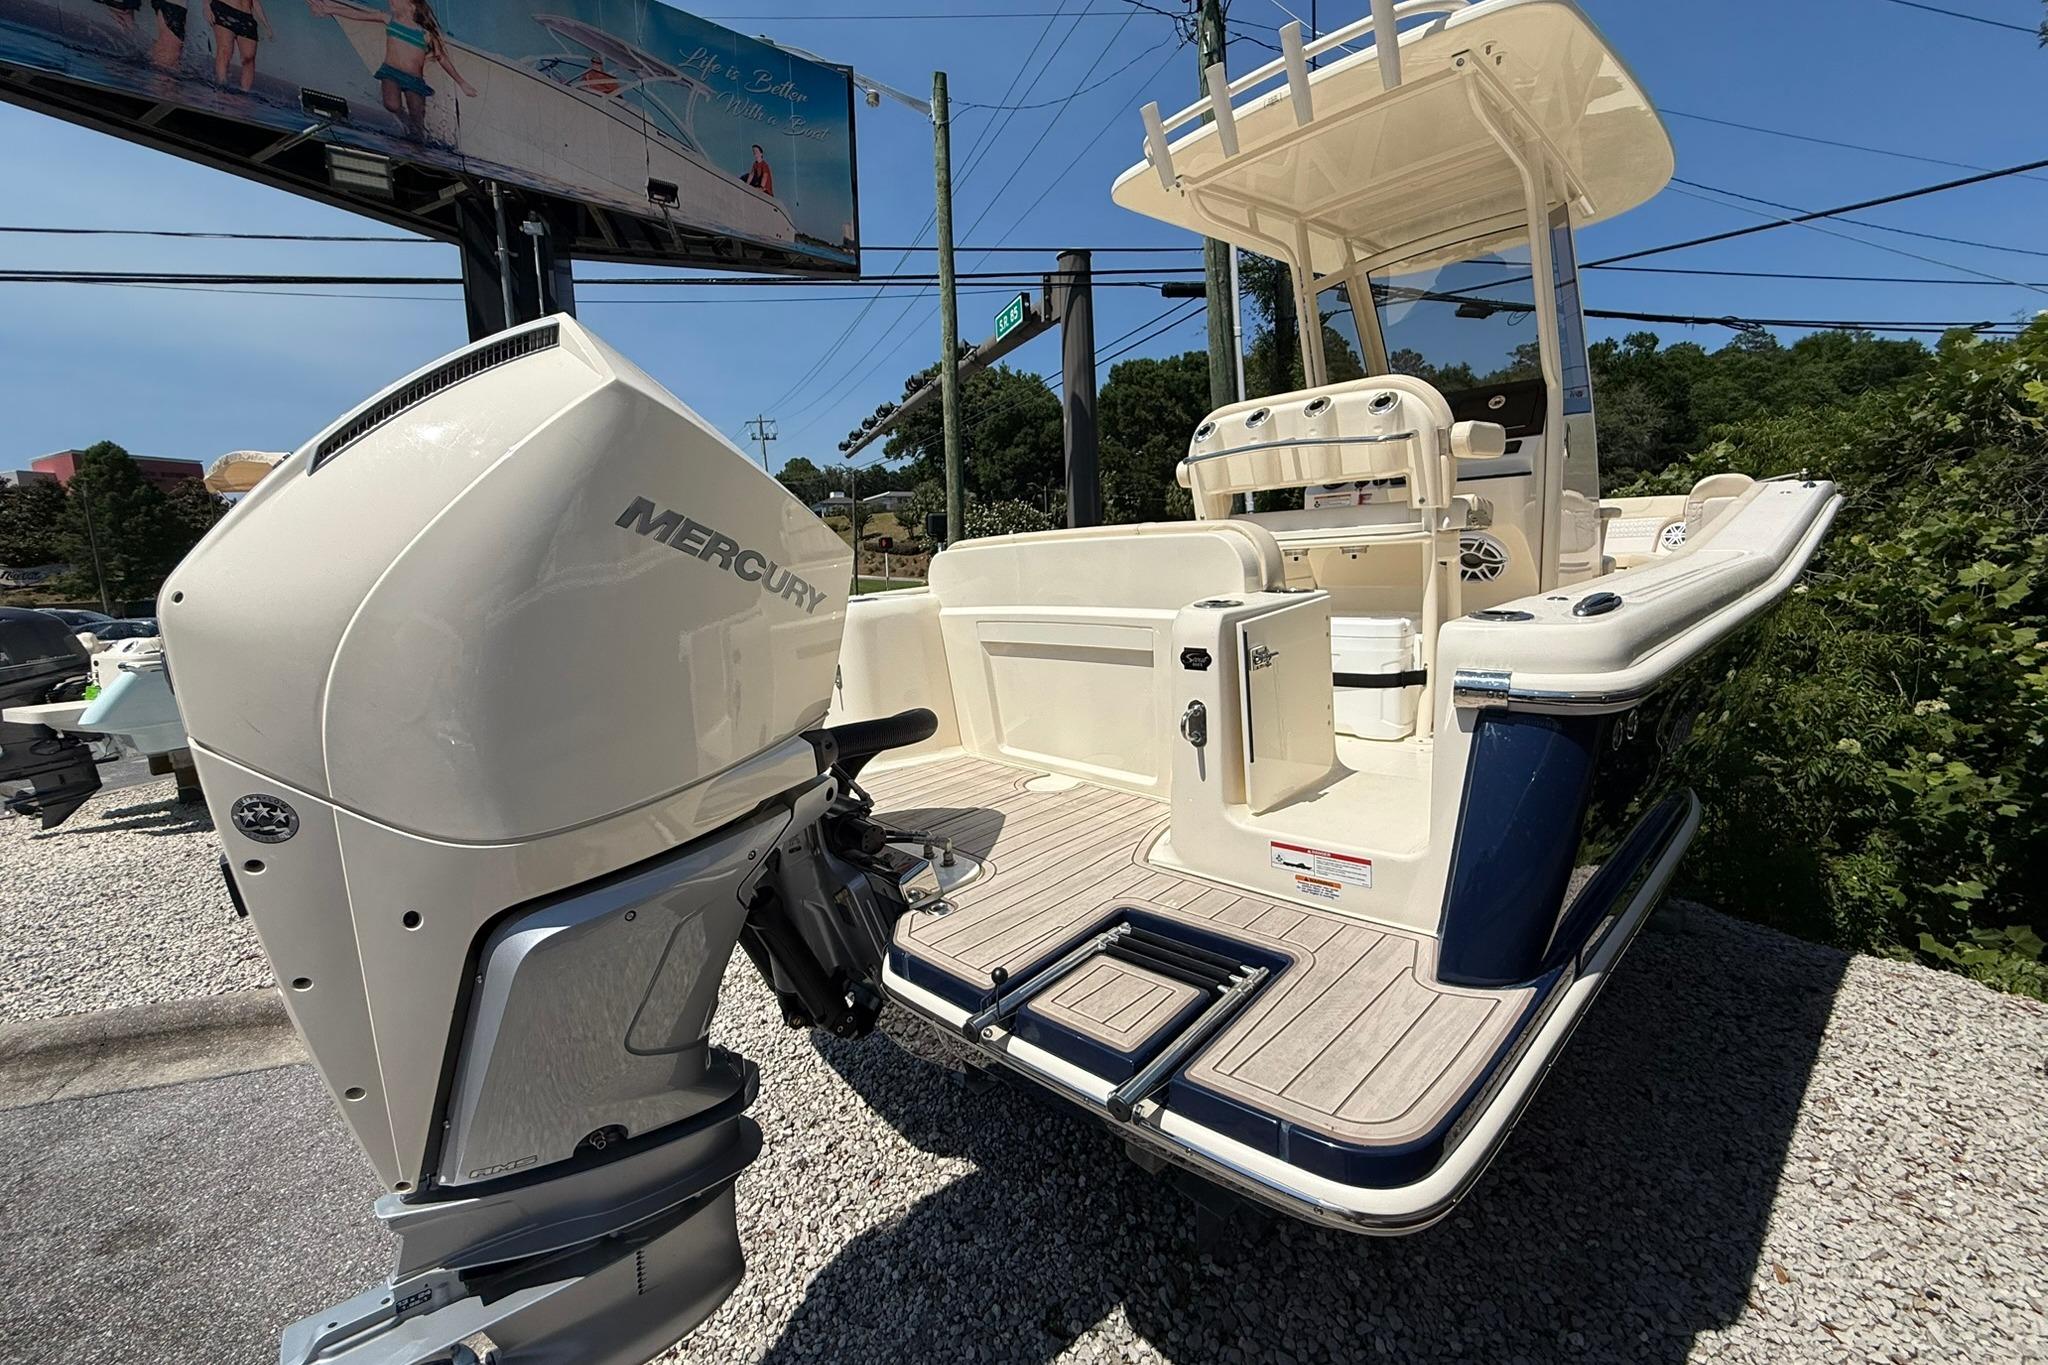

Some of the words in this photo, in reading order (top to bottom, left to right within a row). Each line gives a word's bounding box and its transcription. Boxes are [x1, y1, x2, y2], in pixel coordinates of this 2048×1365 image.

[679, 47, 722, 81] Life
[725, 64, 740, 81] is
[745, 69, 808, 104] Better
[717, 91, 765, 121] With
[767, 117, 777, 127] a
[783, 114, 832, 142] Boat
[614, 495, 828, 615] MERCURY
